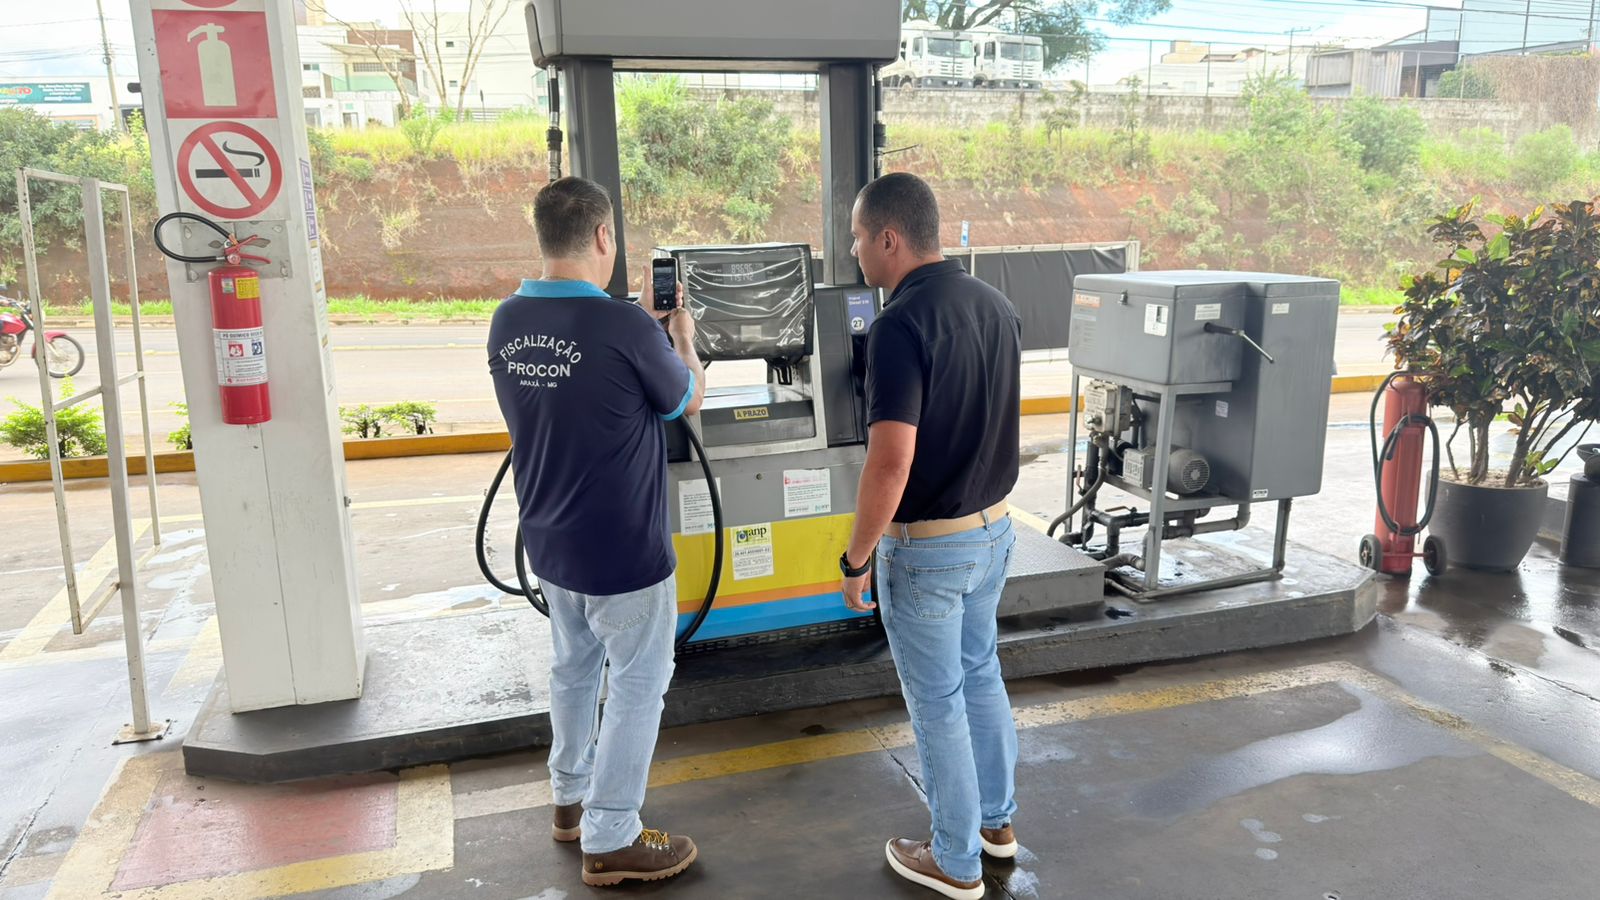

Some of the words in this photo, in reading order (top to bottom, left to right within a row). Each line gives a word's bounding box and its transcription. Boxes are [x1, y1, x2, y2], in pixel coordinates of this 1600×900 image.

[853, 319, 863, 328] 27
[499, 334, 582, 364] FISCALIZAÇÃO
[507, 361, 571, 377] PROCON
[736, 410, 742, 418] A
[743, 409, 767, 418] PRAZO
[748, 527, 767, 538] anp
